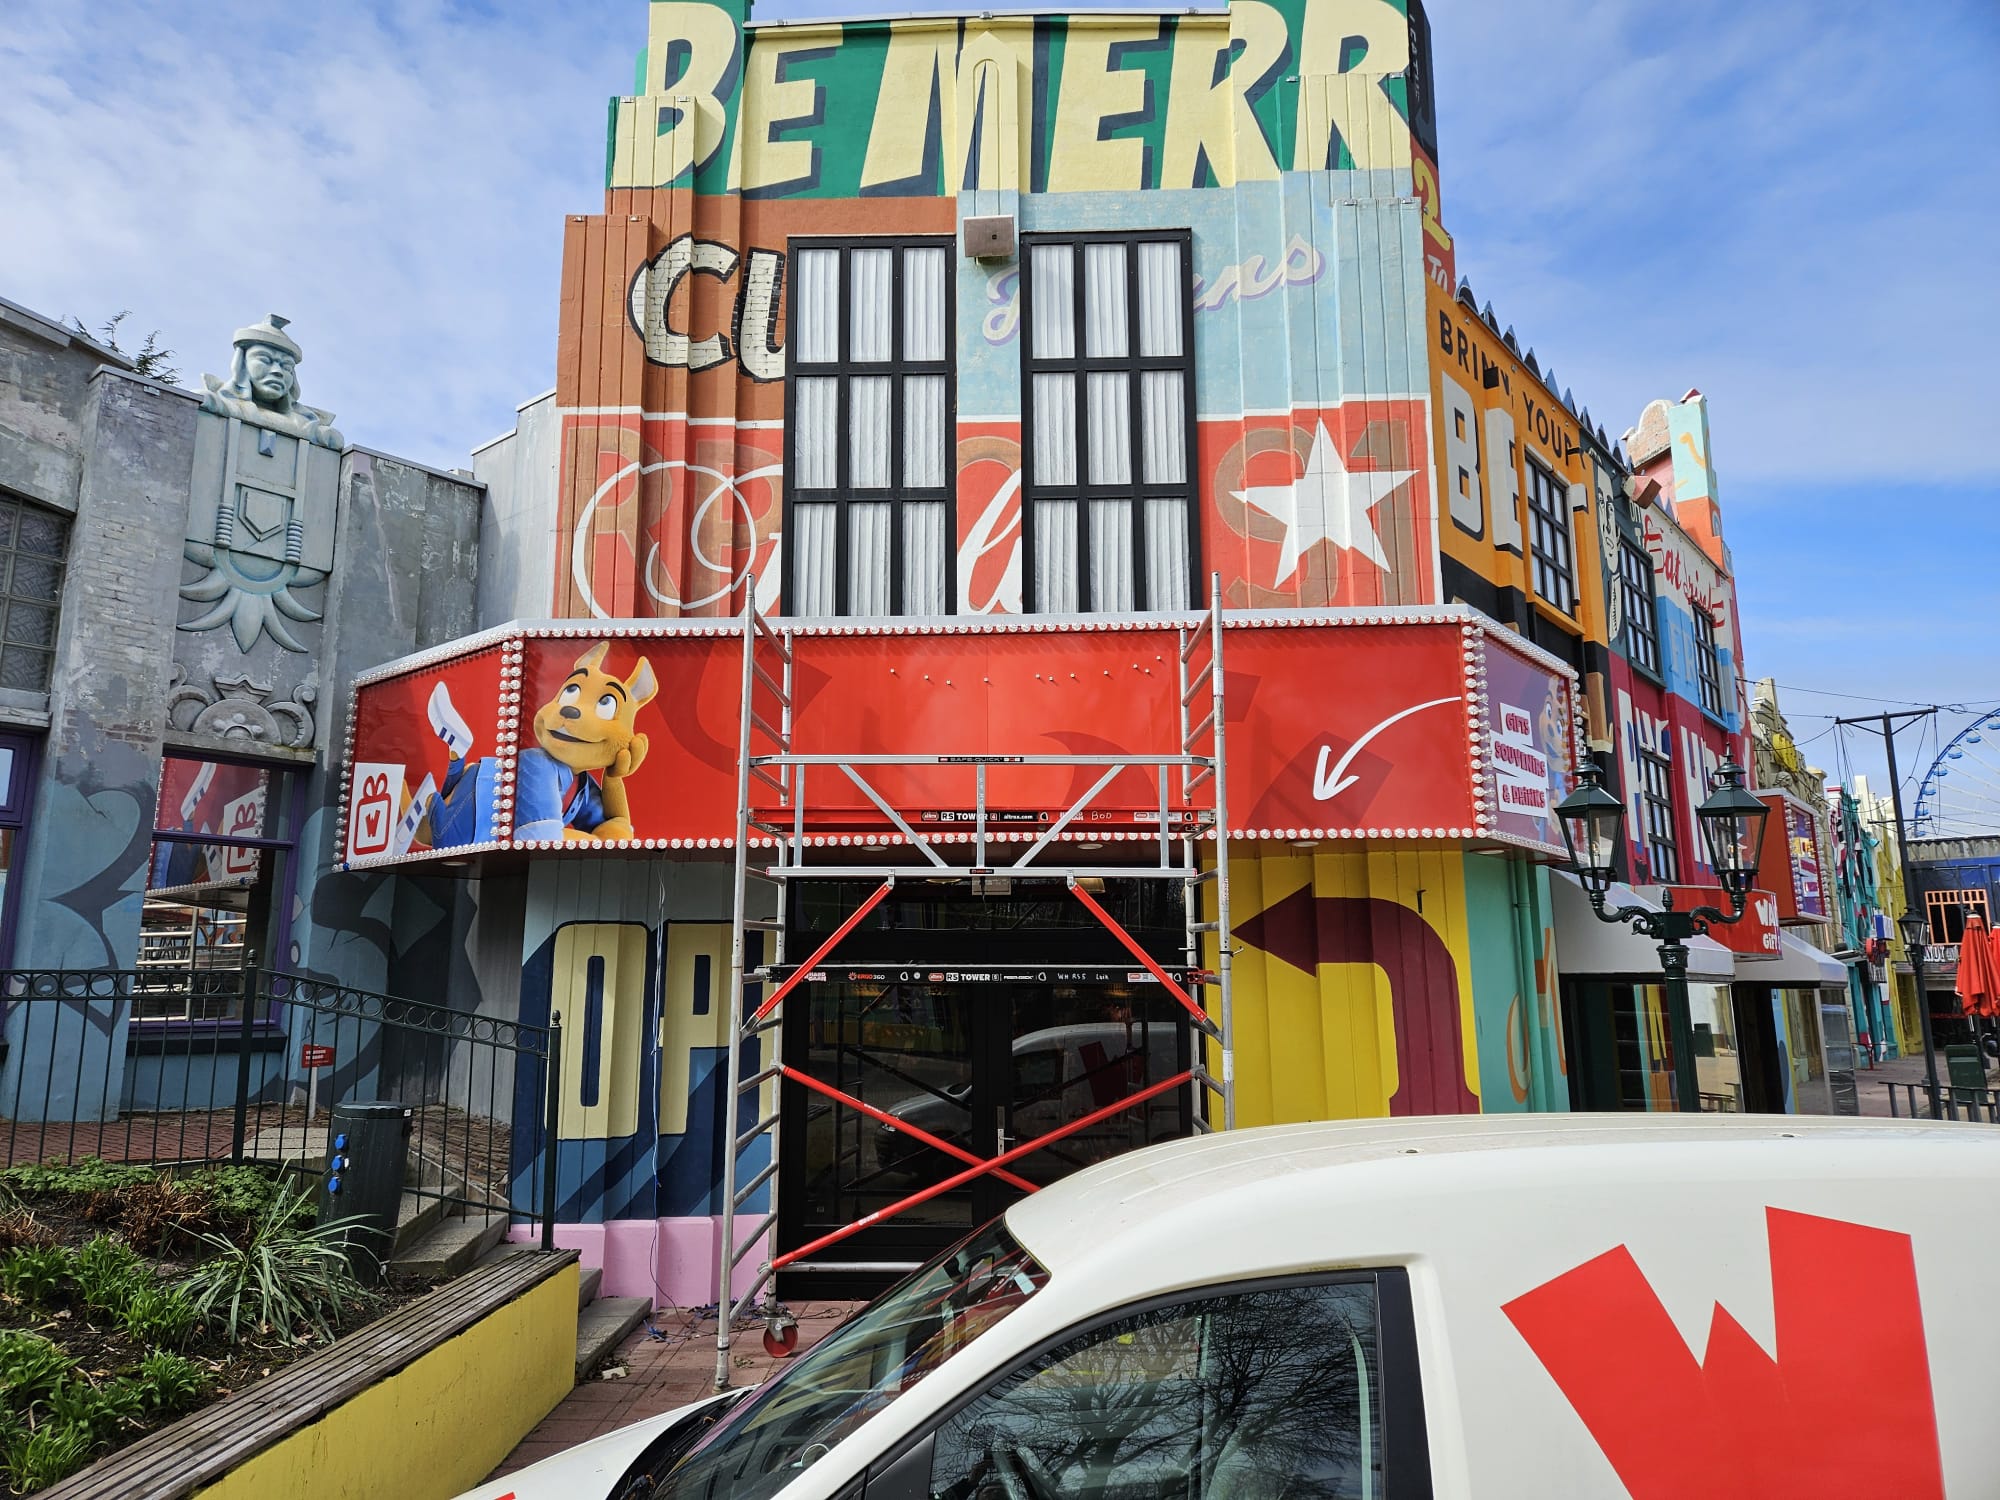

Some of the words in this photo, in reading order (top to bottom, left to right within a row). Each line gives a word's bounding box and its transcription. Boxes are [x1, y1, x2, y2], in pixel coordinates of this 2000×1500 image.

[941, 812, 954, 821] RS
[956, 812, 988, 821] TOWR
[946, 973, 959, 981] RS
[961, 973, 990, 981] TOWER
